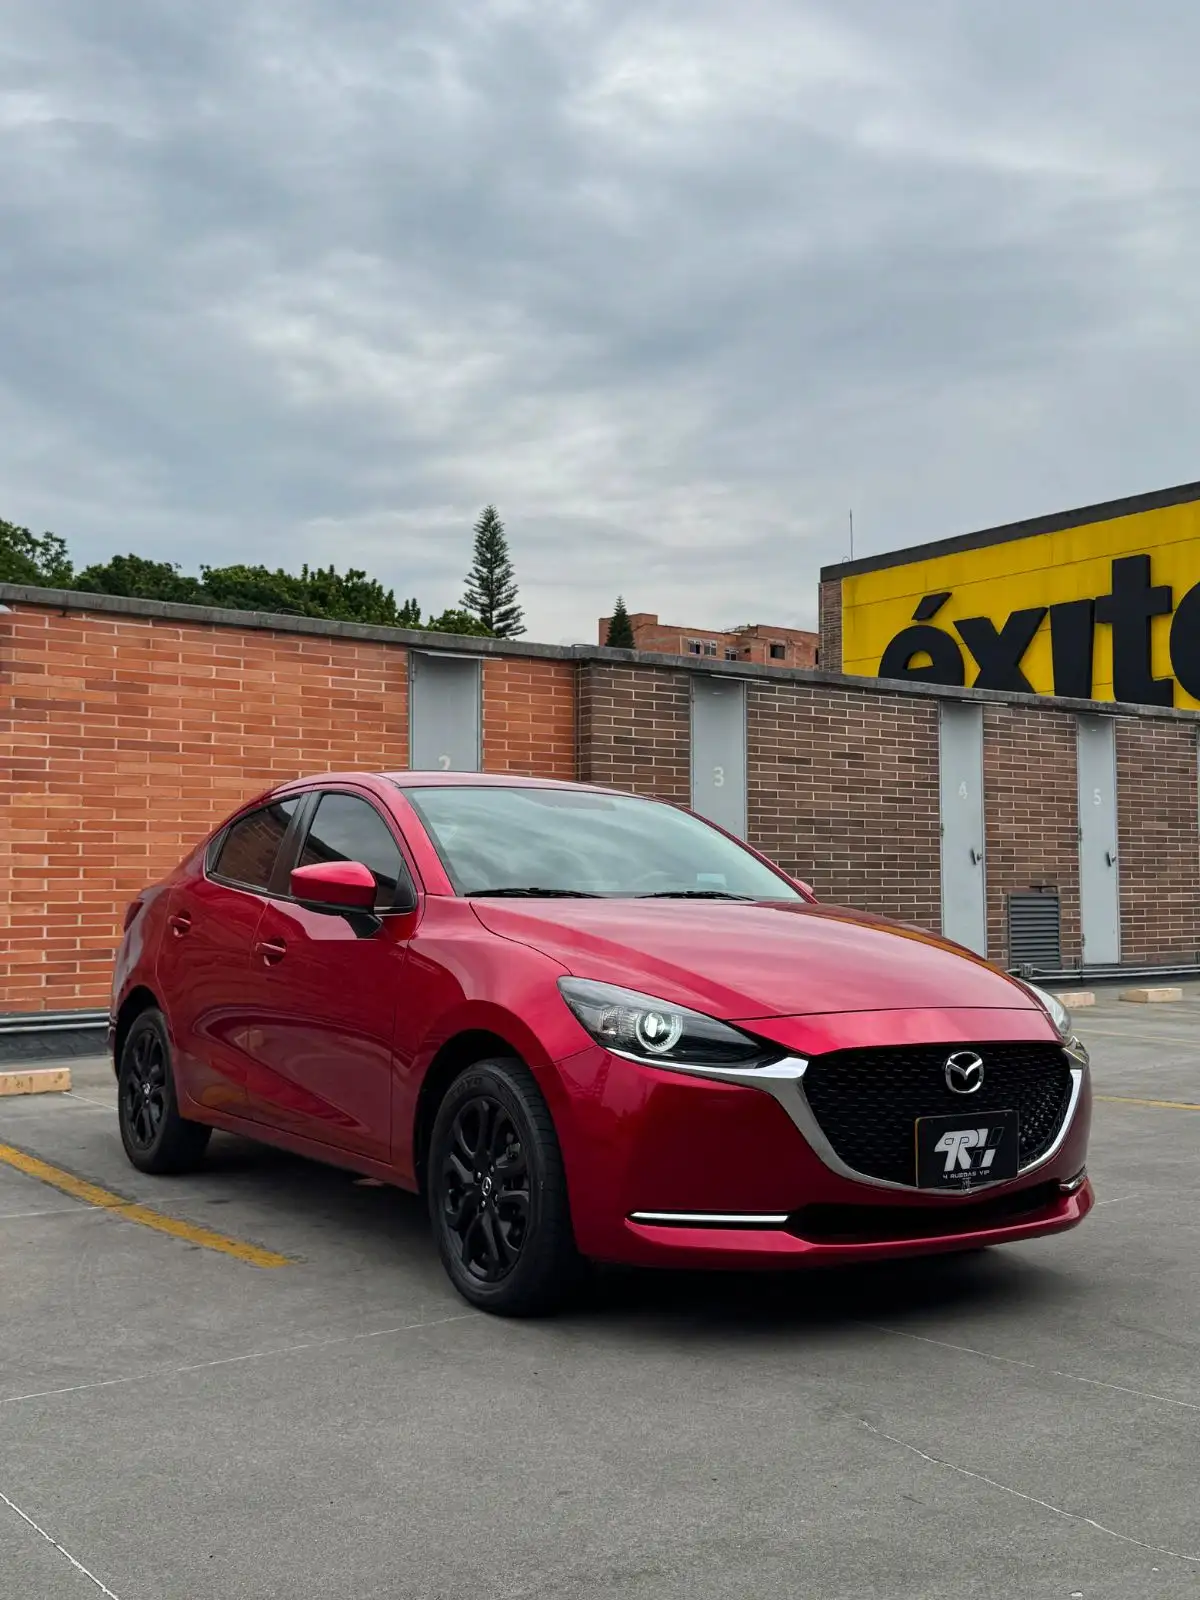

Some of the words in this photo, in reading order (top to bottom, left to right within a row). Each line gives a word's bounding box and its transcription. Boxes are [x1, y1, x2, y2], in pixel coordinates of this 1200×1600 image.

[713, 766, 724, 787] 3
[958, 781, 969, 800] 4
[1093, 787, 1102, 805] 5
[950, 1171, 977, 1179] RUEDAS
